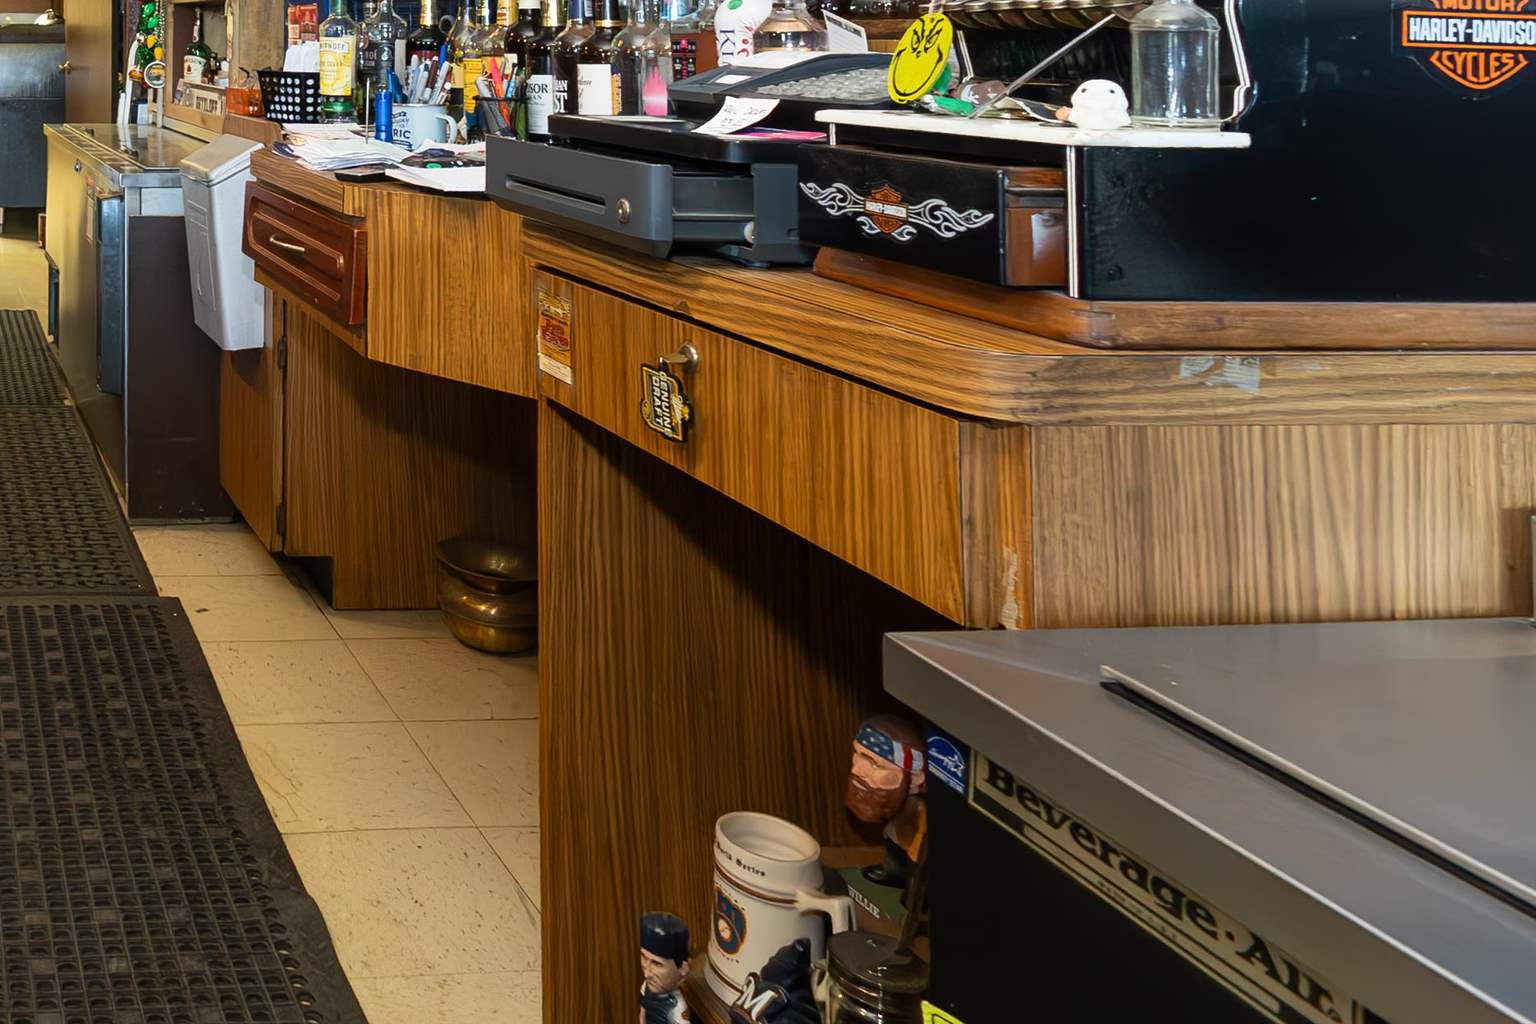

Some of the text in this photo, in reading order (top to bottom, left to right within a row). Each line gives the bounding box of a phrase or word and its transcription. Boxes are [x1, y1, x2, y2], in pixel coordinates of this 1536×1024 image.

[1440, 53, 1519, 85] CYCLES
[652, 376, 664, 426] DRAFT
[659, 371, 673, 435] GENUINE
[847, 884, 881, 920] WILLIE
